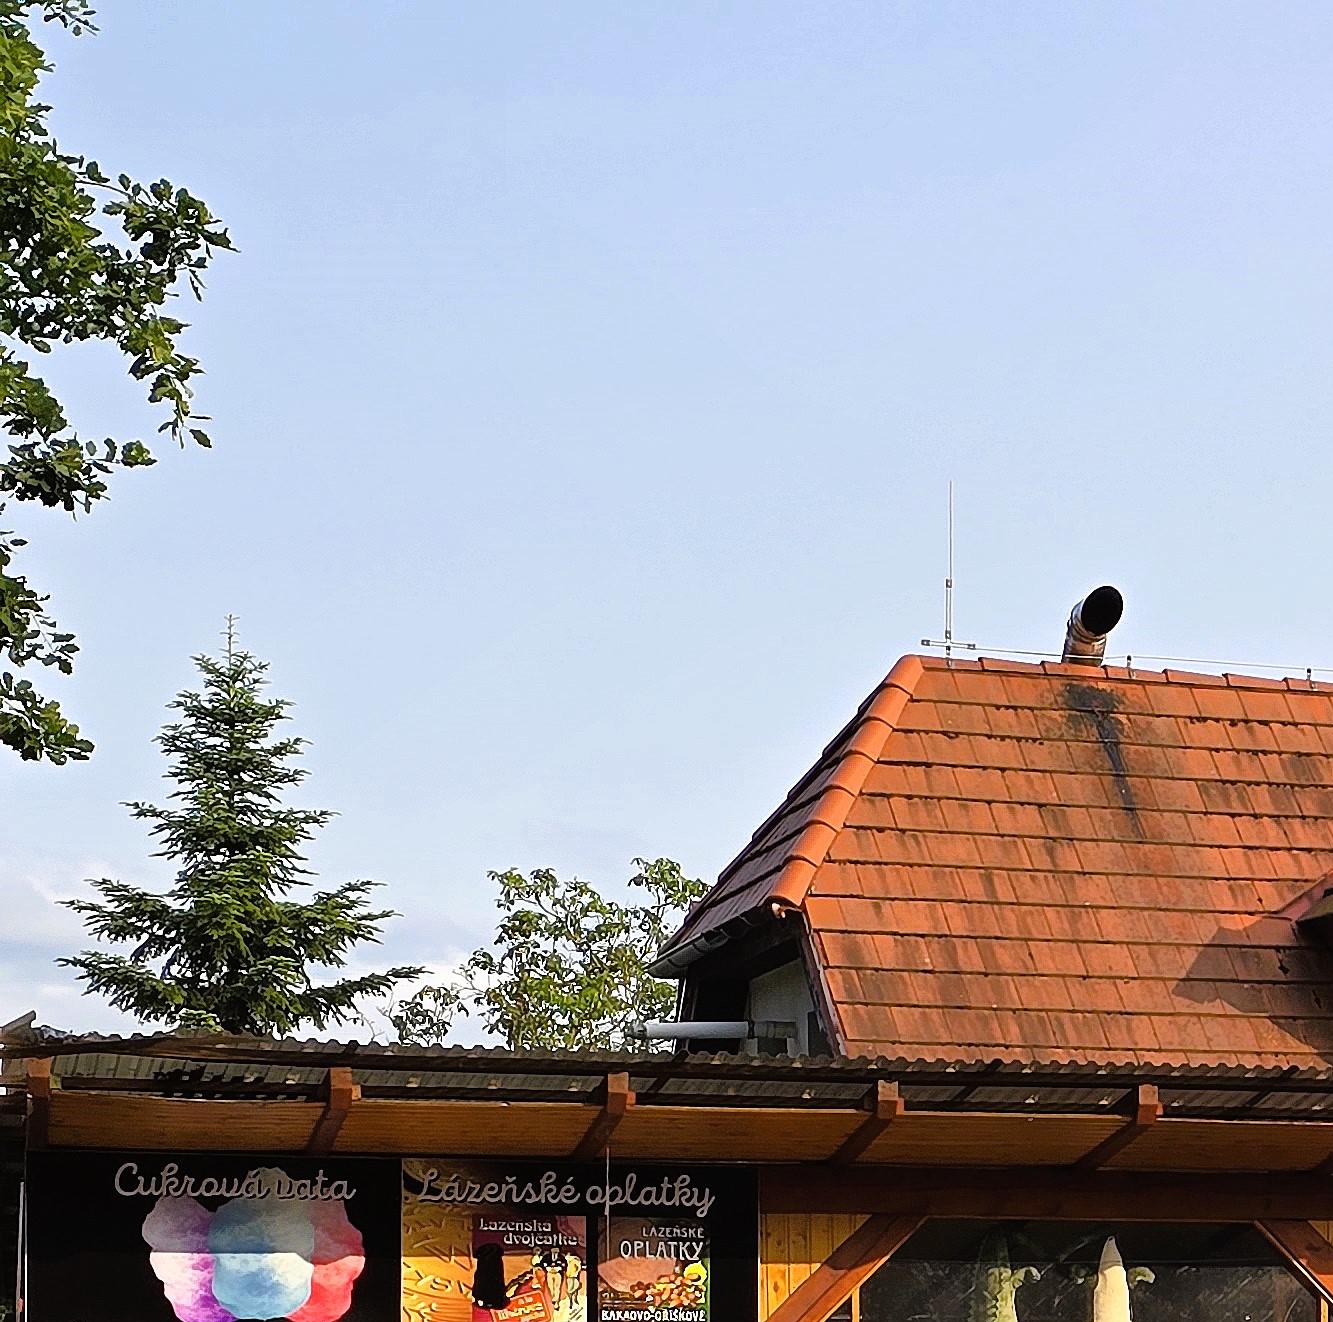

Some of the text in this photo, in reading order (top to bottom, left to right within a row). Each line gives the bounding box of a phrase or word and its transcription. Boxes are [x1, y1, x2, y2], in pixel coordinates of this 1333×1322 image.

[115, 1162, 356, 1200] Cukrová vata
[419, 1171, 716, 1217] Lázeňské oplatky
[620, 1240, 704, 1261] OPLATKY
